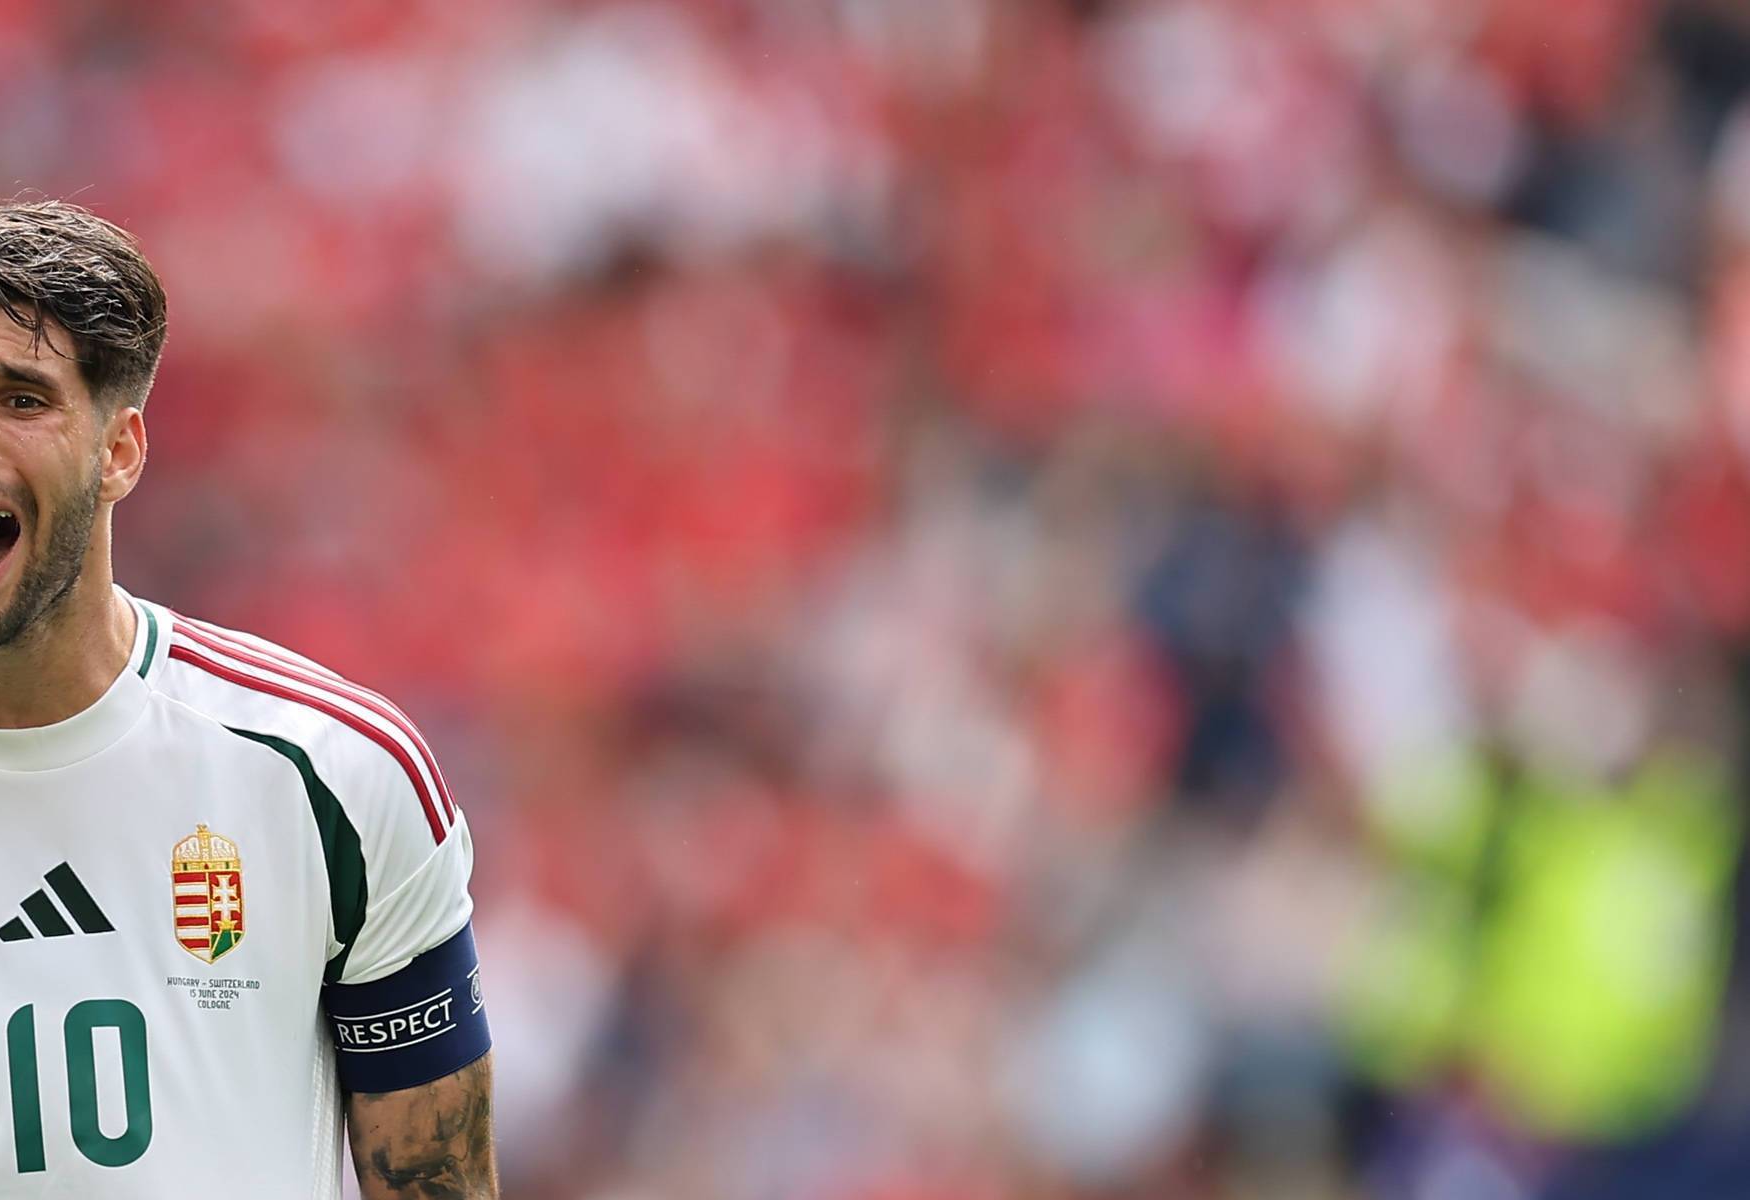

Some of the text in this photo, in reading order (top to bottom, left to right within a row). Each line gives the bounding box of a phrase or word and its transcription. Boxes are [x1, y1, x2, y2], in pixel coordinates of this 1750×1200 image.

[167, 977, 199, 987] HUNGARY
[210, 978, 260, 989] SWITZERLAND
[189, 988, 240, 999] 15 JUNE 2024
[197, 999, 231, 1009] COLOGNE
[337, 998, 452, 1044] RESPECT
[7, 999, 153, 1173] 10
